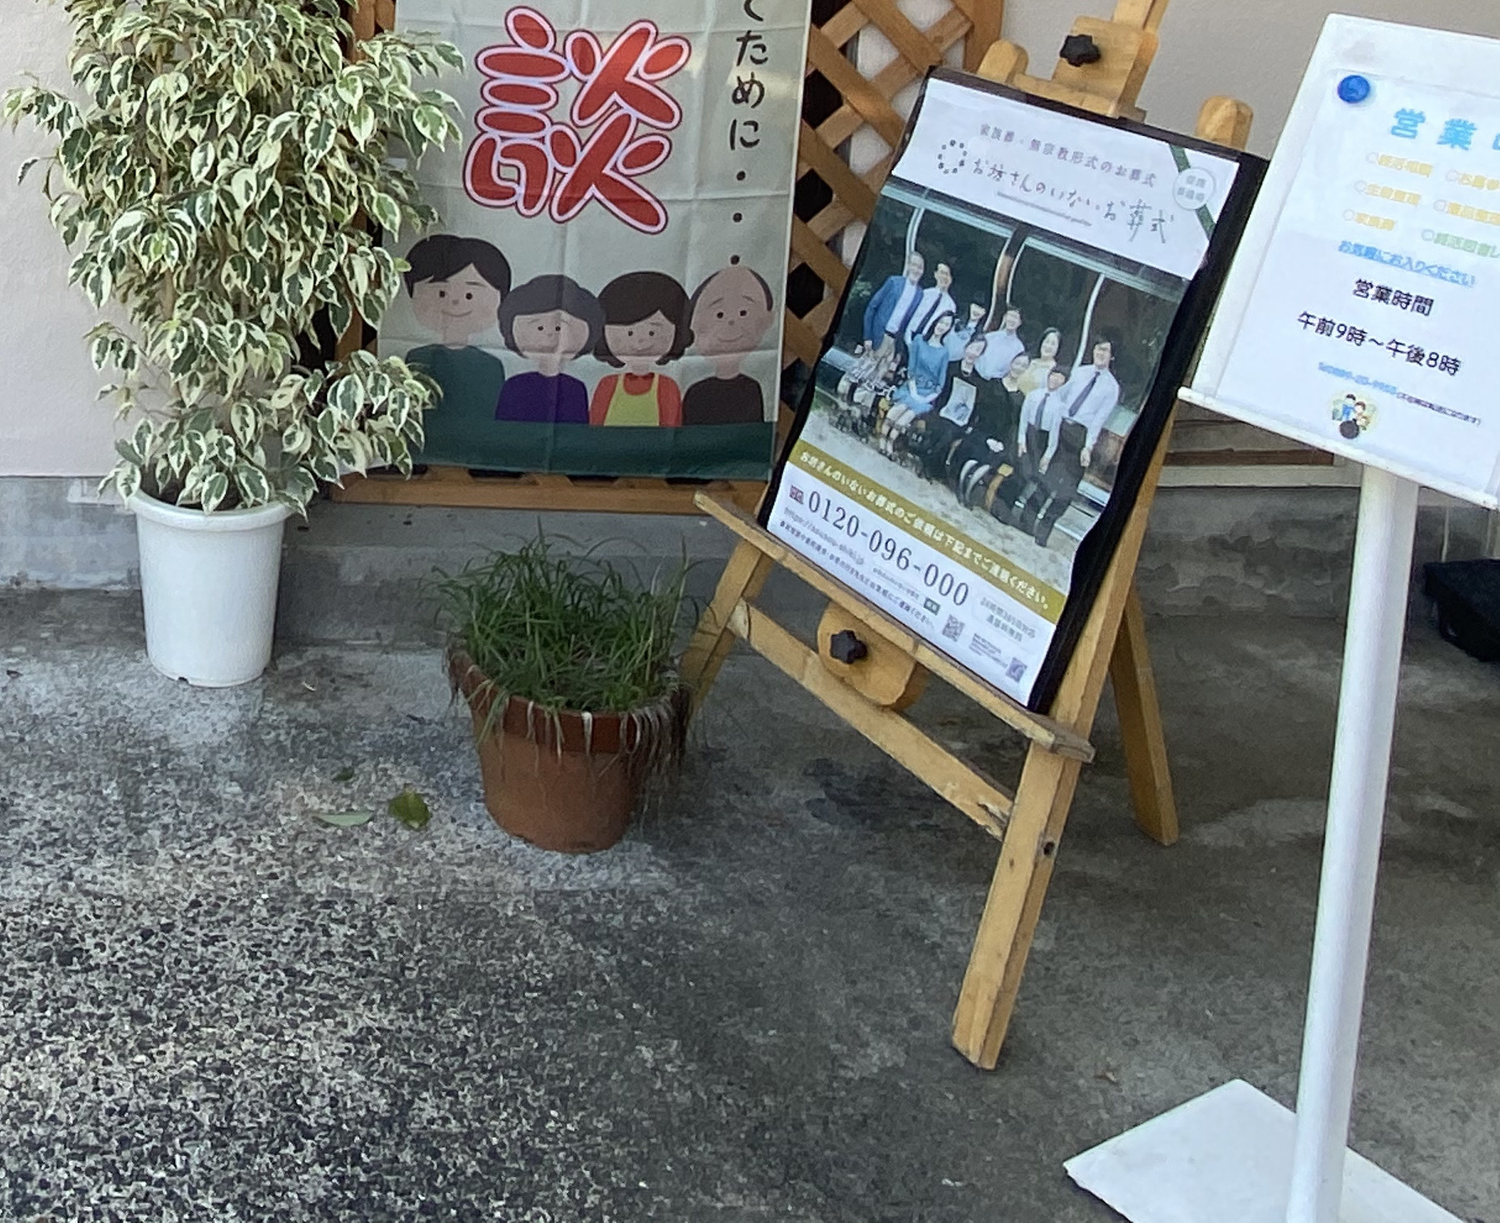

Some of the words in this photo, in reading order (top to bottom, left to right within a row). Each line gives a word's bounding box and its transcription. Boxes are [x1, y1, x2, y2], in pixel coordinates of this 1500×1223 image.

[1389, 107, 1500, 152] 営業
[1352, 278, 1435, 317] 営業時間
[808, 491, 969, 607] 0120-096-000
